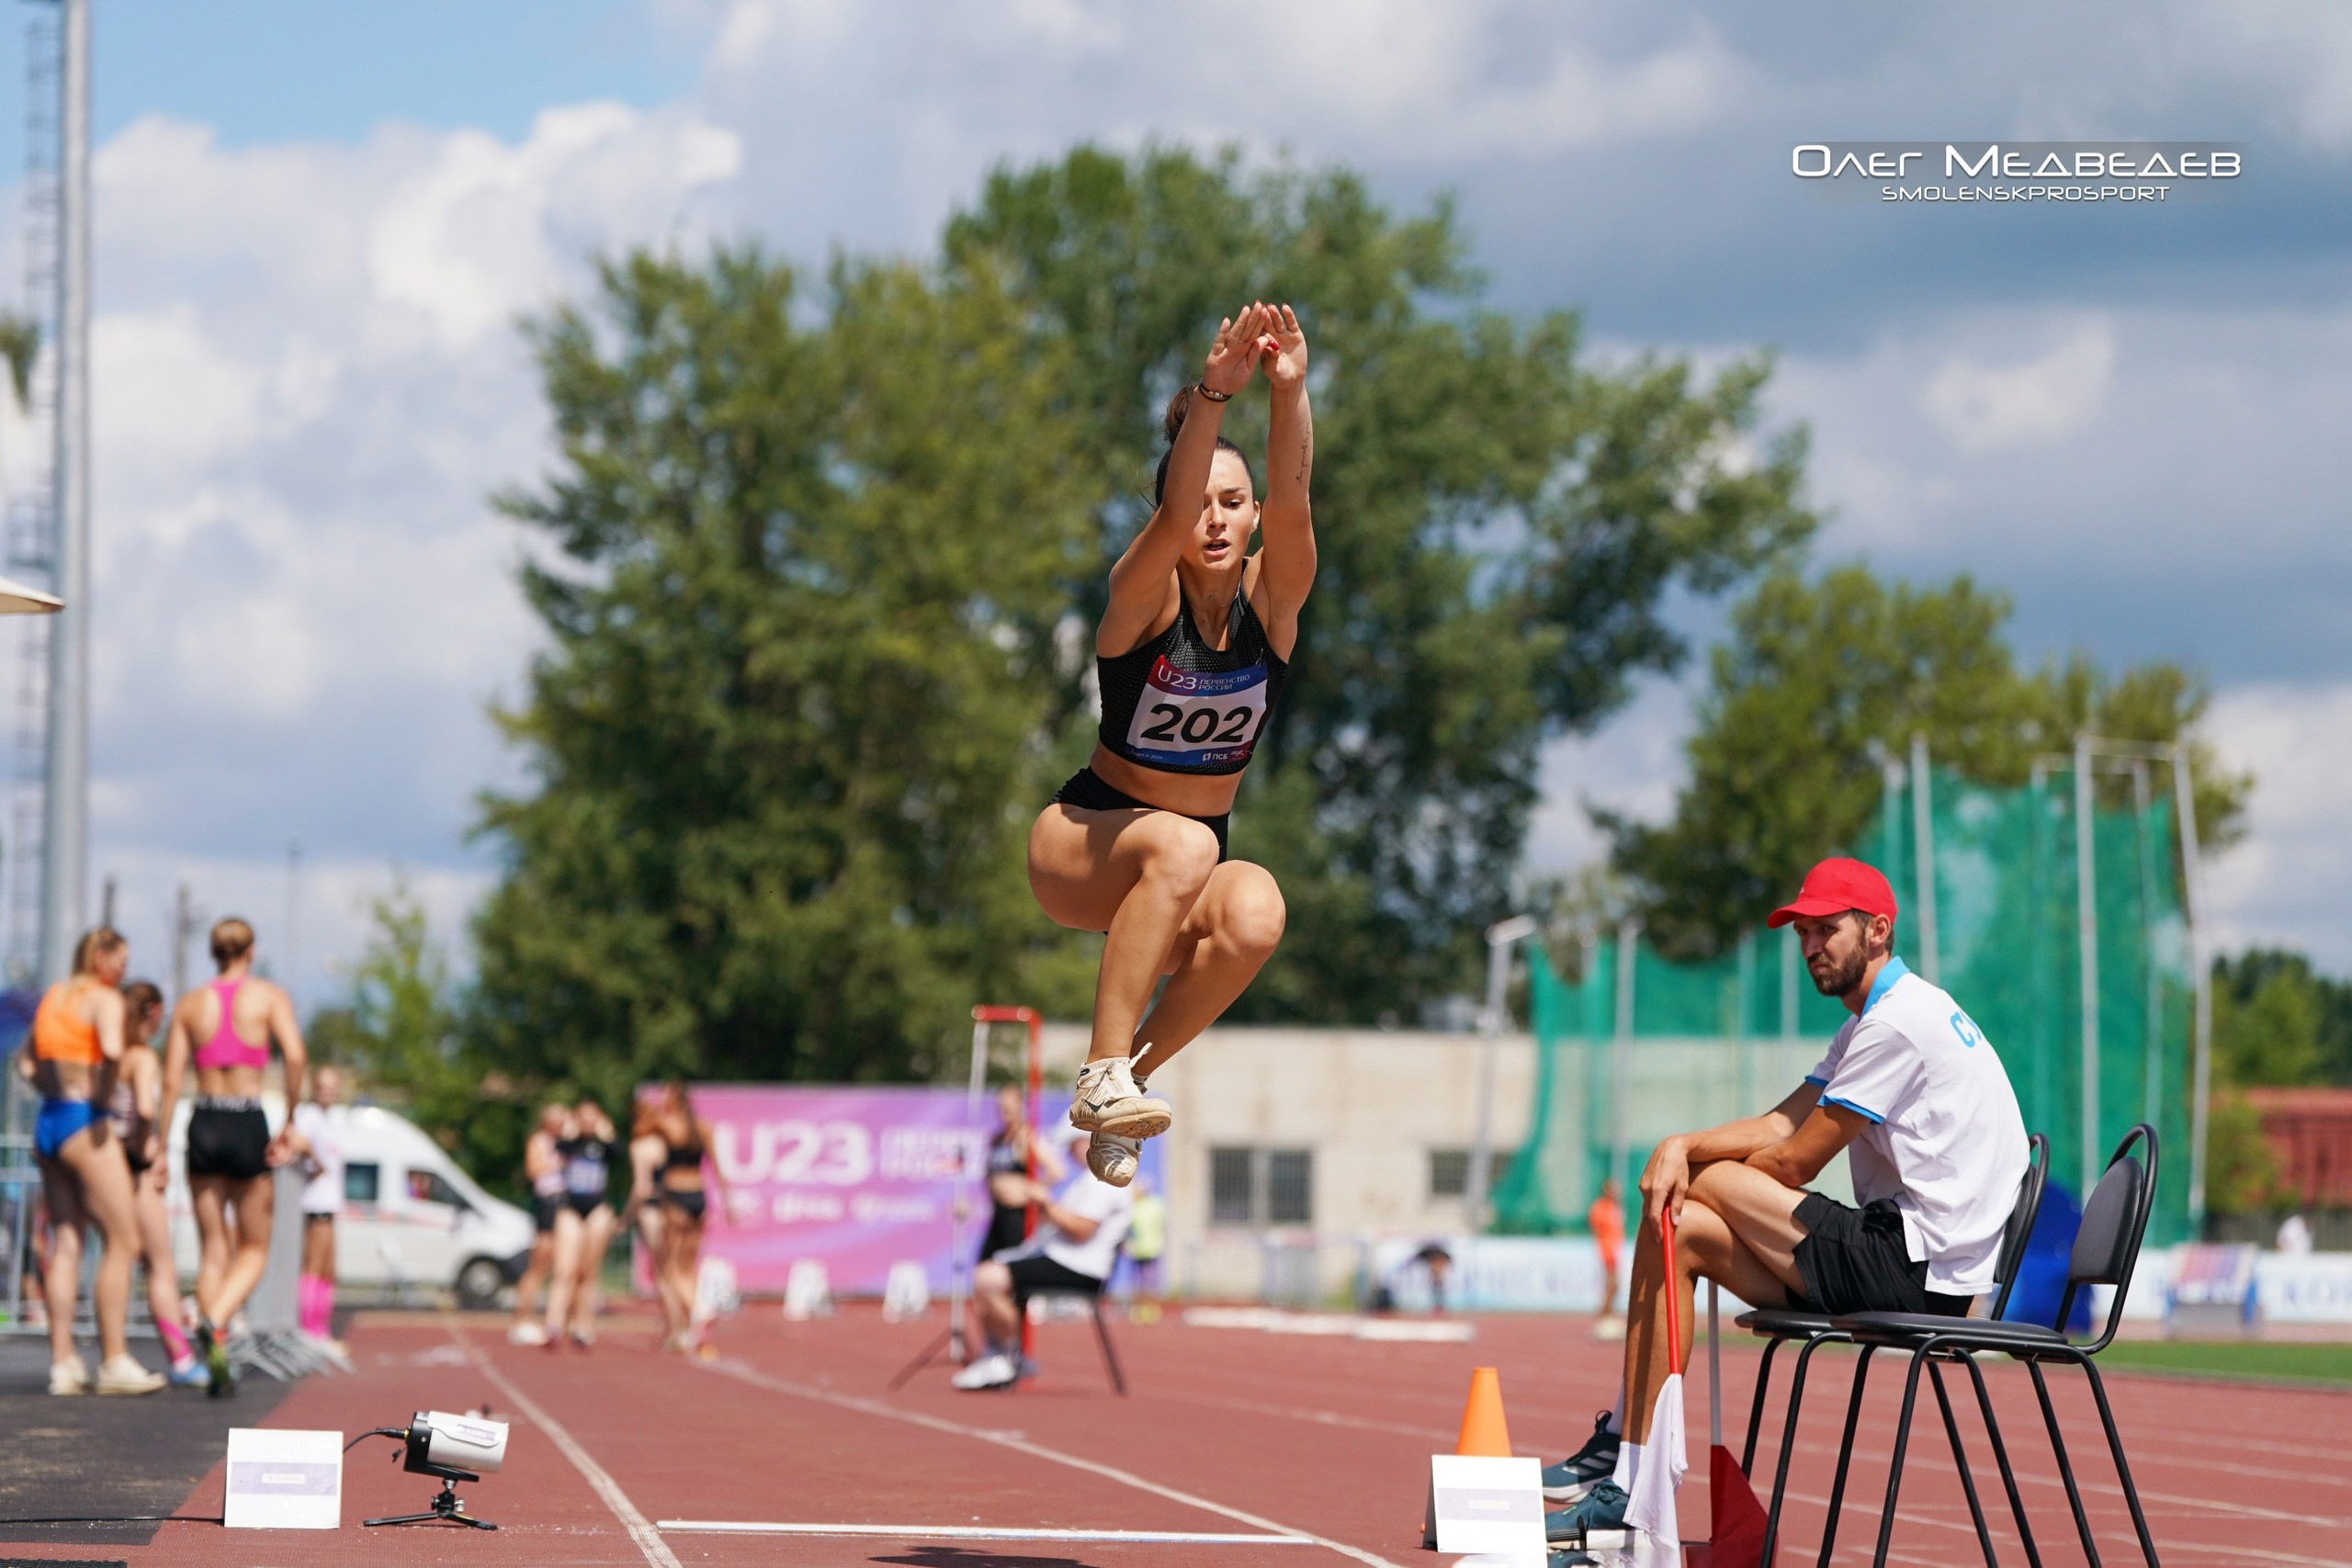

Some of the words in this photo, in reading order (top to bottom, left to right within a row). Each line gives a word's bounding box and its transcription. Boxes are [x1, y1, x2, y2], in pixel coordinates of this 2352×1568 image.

[1158, 665, 1197, 690] U23
[1200, 674, 1250, 685] ПЕРВЕНСТВО
[1140, 703, 1252, 744] 202
[714, 1122, 871, 1186] U23
